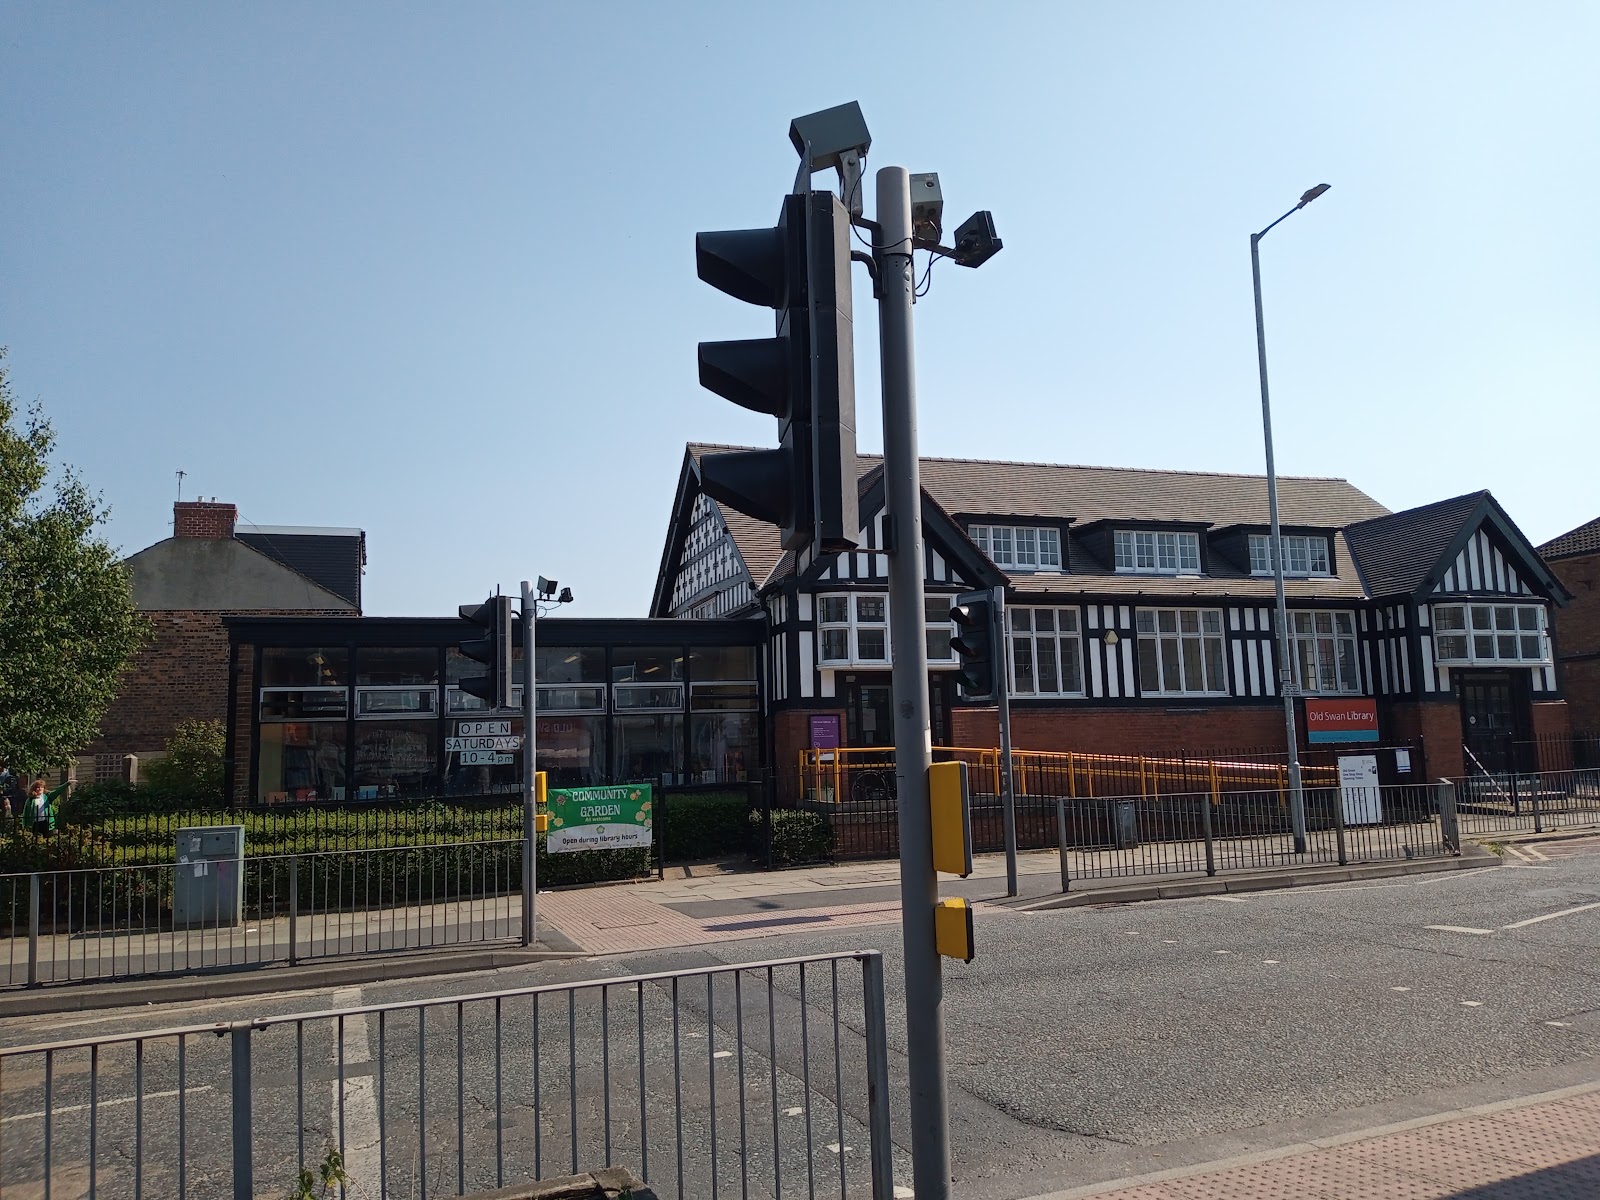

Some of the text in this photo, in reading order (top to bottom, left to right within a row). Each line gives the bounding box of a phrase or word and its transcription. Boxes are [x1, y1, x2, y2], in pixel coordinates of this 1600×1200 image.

[1309, 710, 1374, 722] Old Swan Library
[461, 722, 509, 734] OPEN
[445, 737, 519, 750] SATURDAYS
[572, 789, 628, 802] COMMUNITY
[580, 804, 621, 817] GARDEN
[562, 832, 638, 846] Open during library hours
